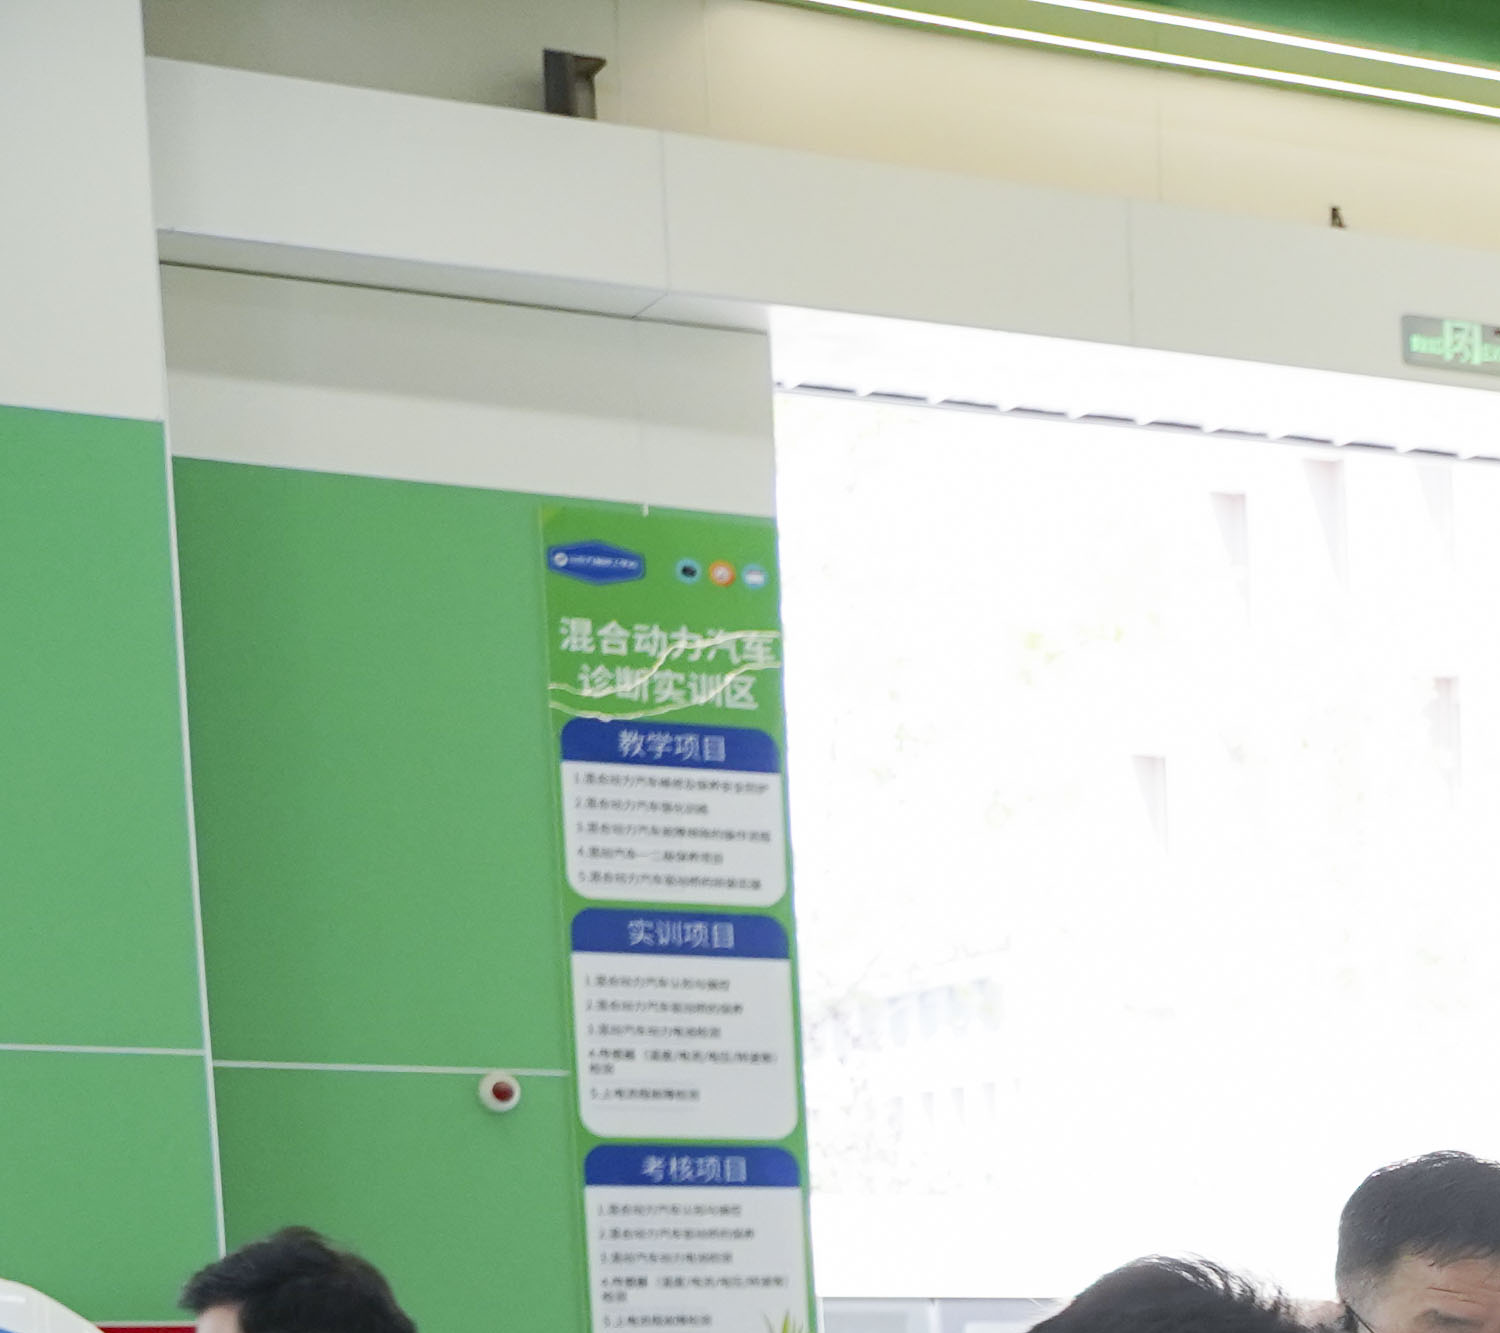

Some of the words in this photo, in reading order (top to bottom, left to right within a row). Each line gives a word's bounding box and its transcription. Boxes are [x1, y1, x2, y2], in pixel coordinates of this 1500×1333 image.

[559, 616, 776, 666] 混合动力汽车
[578, 664, 759, 711] 诊断实训区
[617, 729, 727, 763] 教学项目
[627, 919, 735, 950] 实训项目
[641, 1156, 748, 1185] 考核项目
